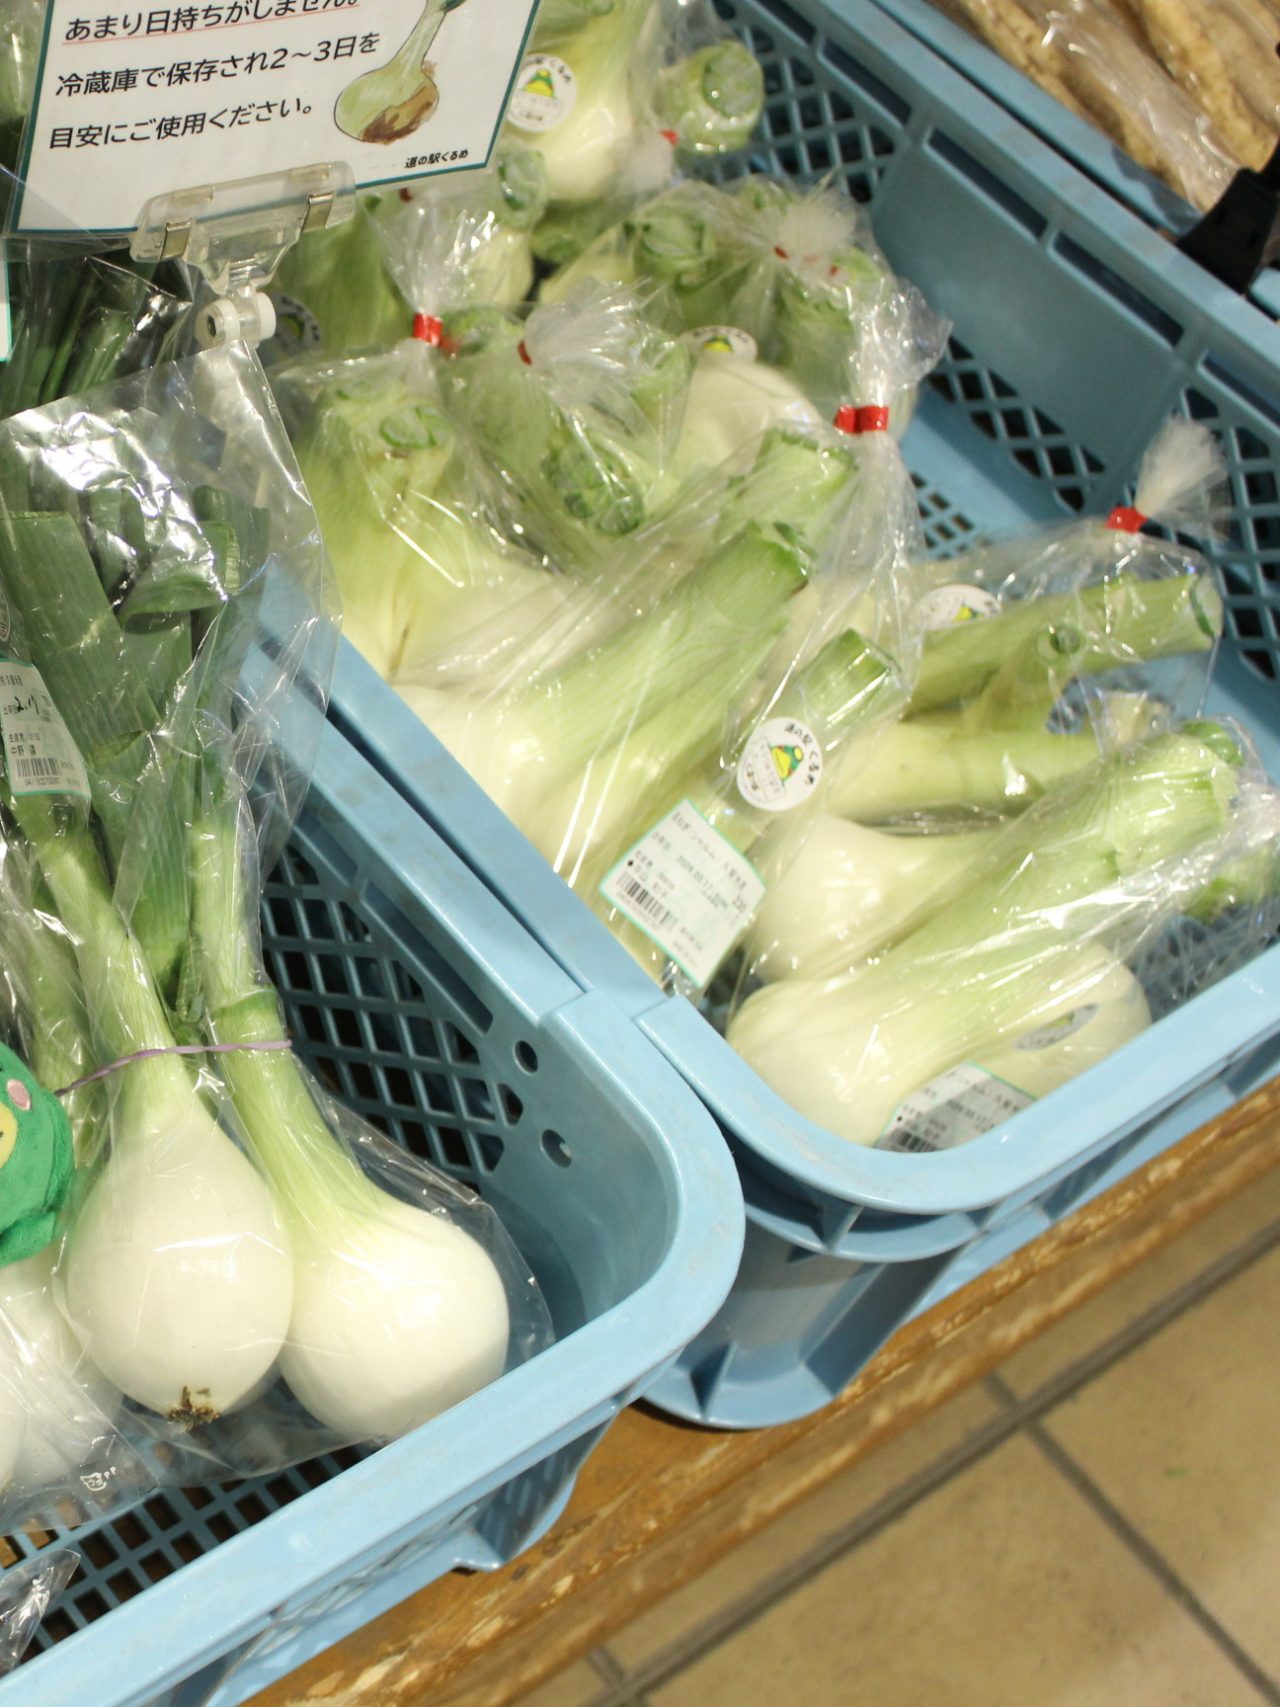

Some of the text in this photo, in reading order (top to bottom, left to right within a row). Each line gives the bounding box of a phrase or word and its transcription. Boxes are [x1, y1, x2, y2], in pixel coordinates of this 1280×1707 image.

[49, 97, 312, 149] 目安にご使用ください。
[405, 149, 469, 168] 道の駅くるめ
